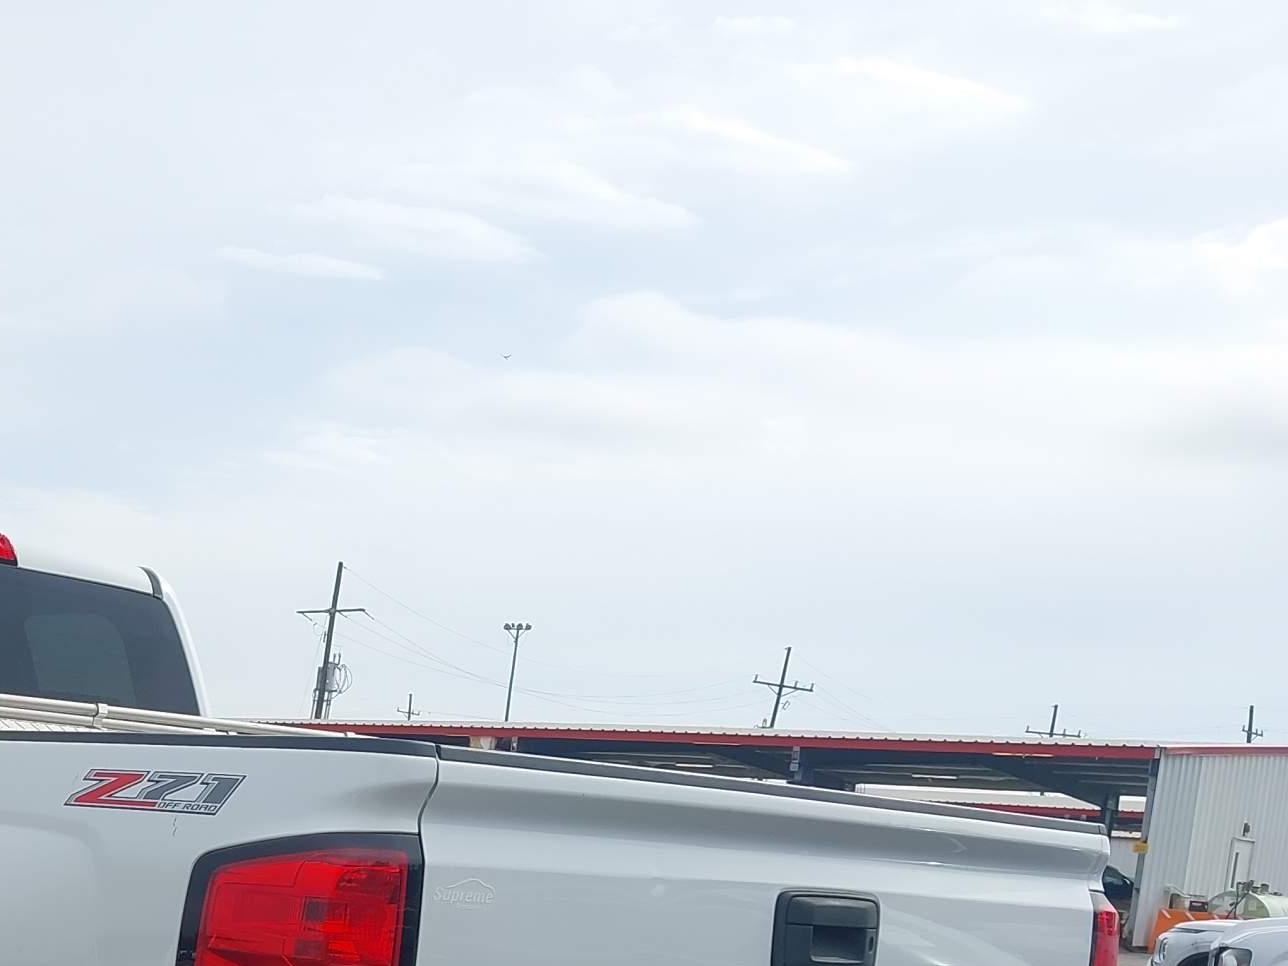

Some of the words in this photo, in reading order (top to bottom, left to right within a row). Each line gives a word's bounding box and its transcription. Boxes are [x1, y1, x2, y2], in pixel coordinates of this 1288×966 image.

[64, 768, 247, 816] Z71
[157, 801, 182, 809] OFF
[182, 803, 217, 812] ROAD
